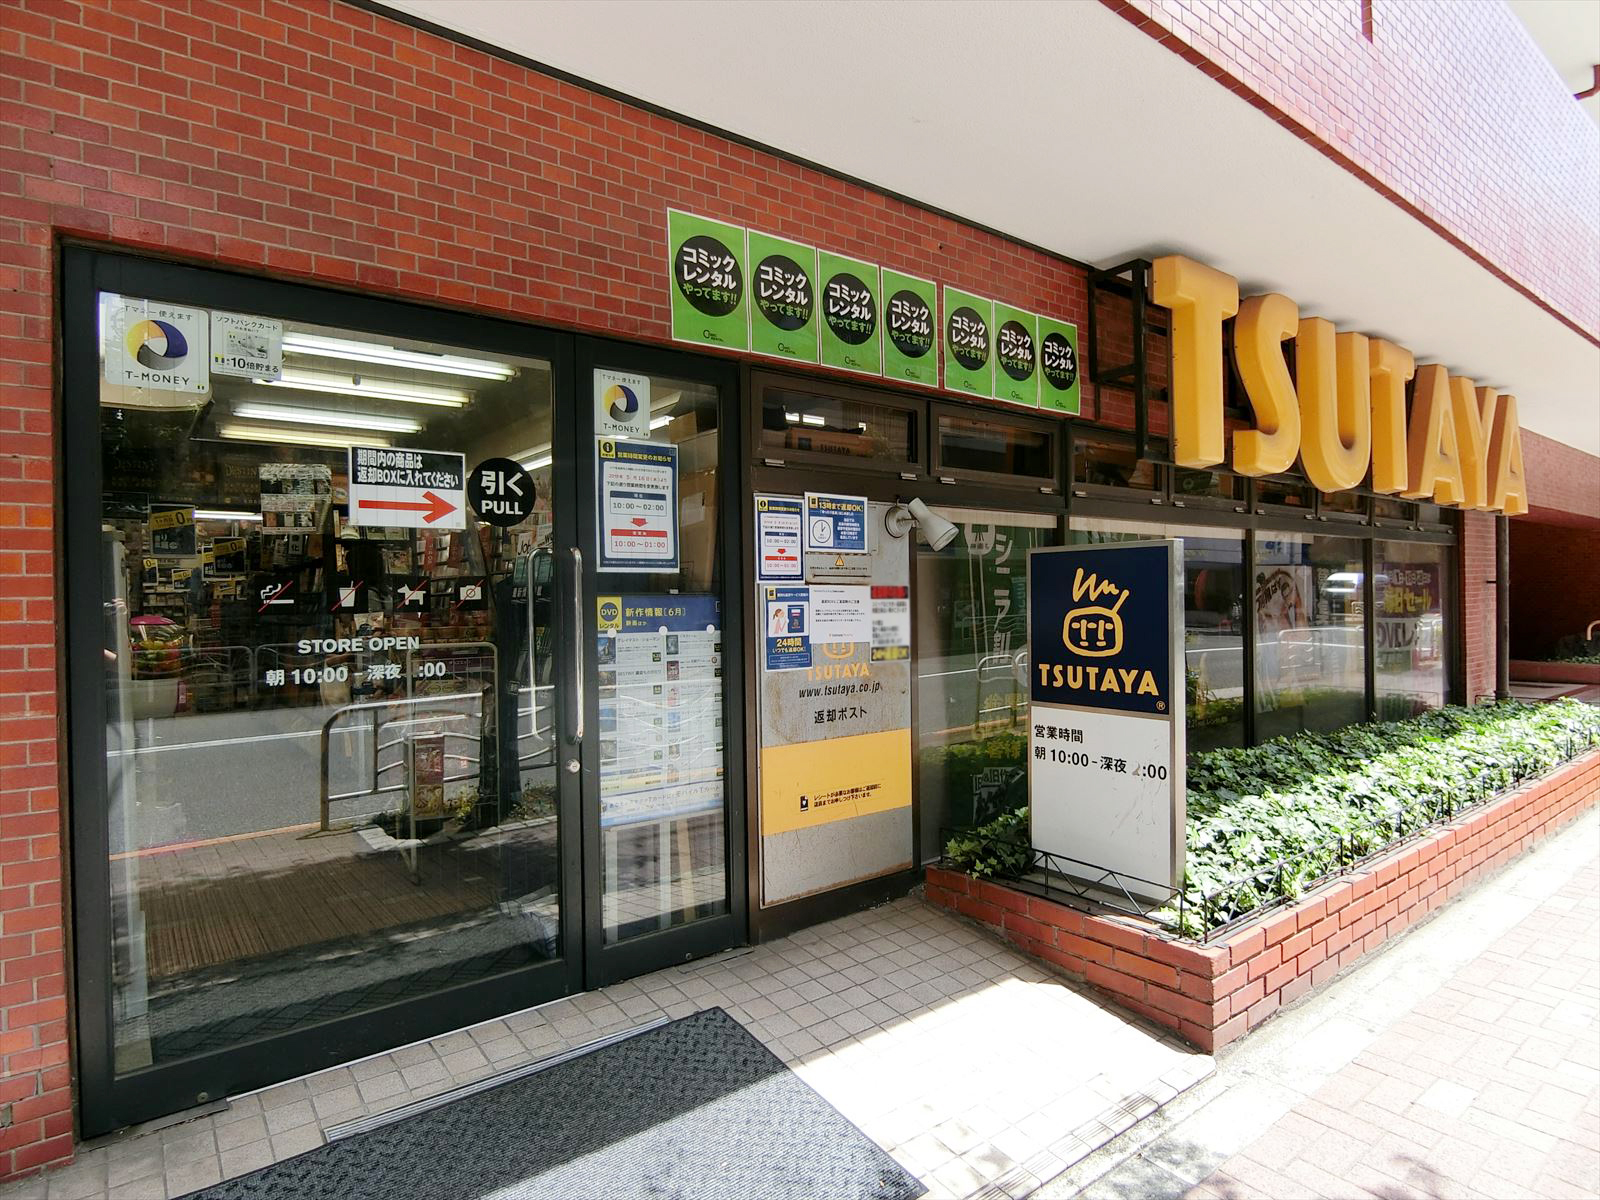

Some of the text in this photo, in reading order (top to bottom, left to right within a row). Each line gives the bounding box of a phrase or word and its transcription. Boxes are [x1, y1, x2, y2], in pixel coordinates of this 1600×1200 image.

[683, 246, 736, 273] コミック
[683, 264, 737, 290] レンタル
[760, 265, 807, 289] コミック
[760, 281, 808, 306] レンタル
[828, 283, 871, 306] コミック
[829, 298, 872, 321] レンタル
[891, 299, 929, 321] コミック
[216, 316, 278, 331] ソフトバンクカード
[892, 314, 930, 335] レンタル
[952, 315, 986, 335] コミック
[952, 329, 986, 349] レンタル
[1001, 328, 1031, 348] コミック
[1001, 341, 1032, 361] レンタル
[1044, 341, 1072, 358] コミック
[1044, 354, 1074, 370] レンタル
[125, 370, 190, 386] T-MONEY
[1153, 254, 1529, 517] TSUTAYA
[603, 422, 640, 434] T-MONEY
[357, 449, 423, 469] 期間内の商品は
[357, 467, 459, 488] 返却BOXに入れてください
[481, 470, 524, 497] 引く
[481, 499, 524, 516] PULL
[601, 608, 618, 617] DVD
[297, 636, 420, 654] STORE OPEN
[776, 637, 802, 647] 24時間
[265, 669, 285, 686] 朝
[291, 666, 349, 685] 10:00
[367, 663, 402, 682] 深夜
[807, 662, 871, 682] TSUTAYA
[1038, 663, 1160, 697] TSUTAYA
[799, 680, 880, 699] www.tsutaya.co.jp
[814, 706, 868, 724] 返却ポスト
[1034, 724, 1083, 744] 営業時間
[1034, 746, 1046, 761] 朝
[1050, 748, 1089, 767] 10:00
[1100, 755, 1127, 775] 深夜
